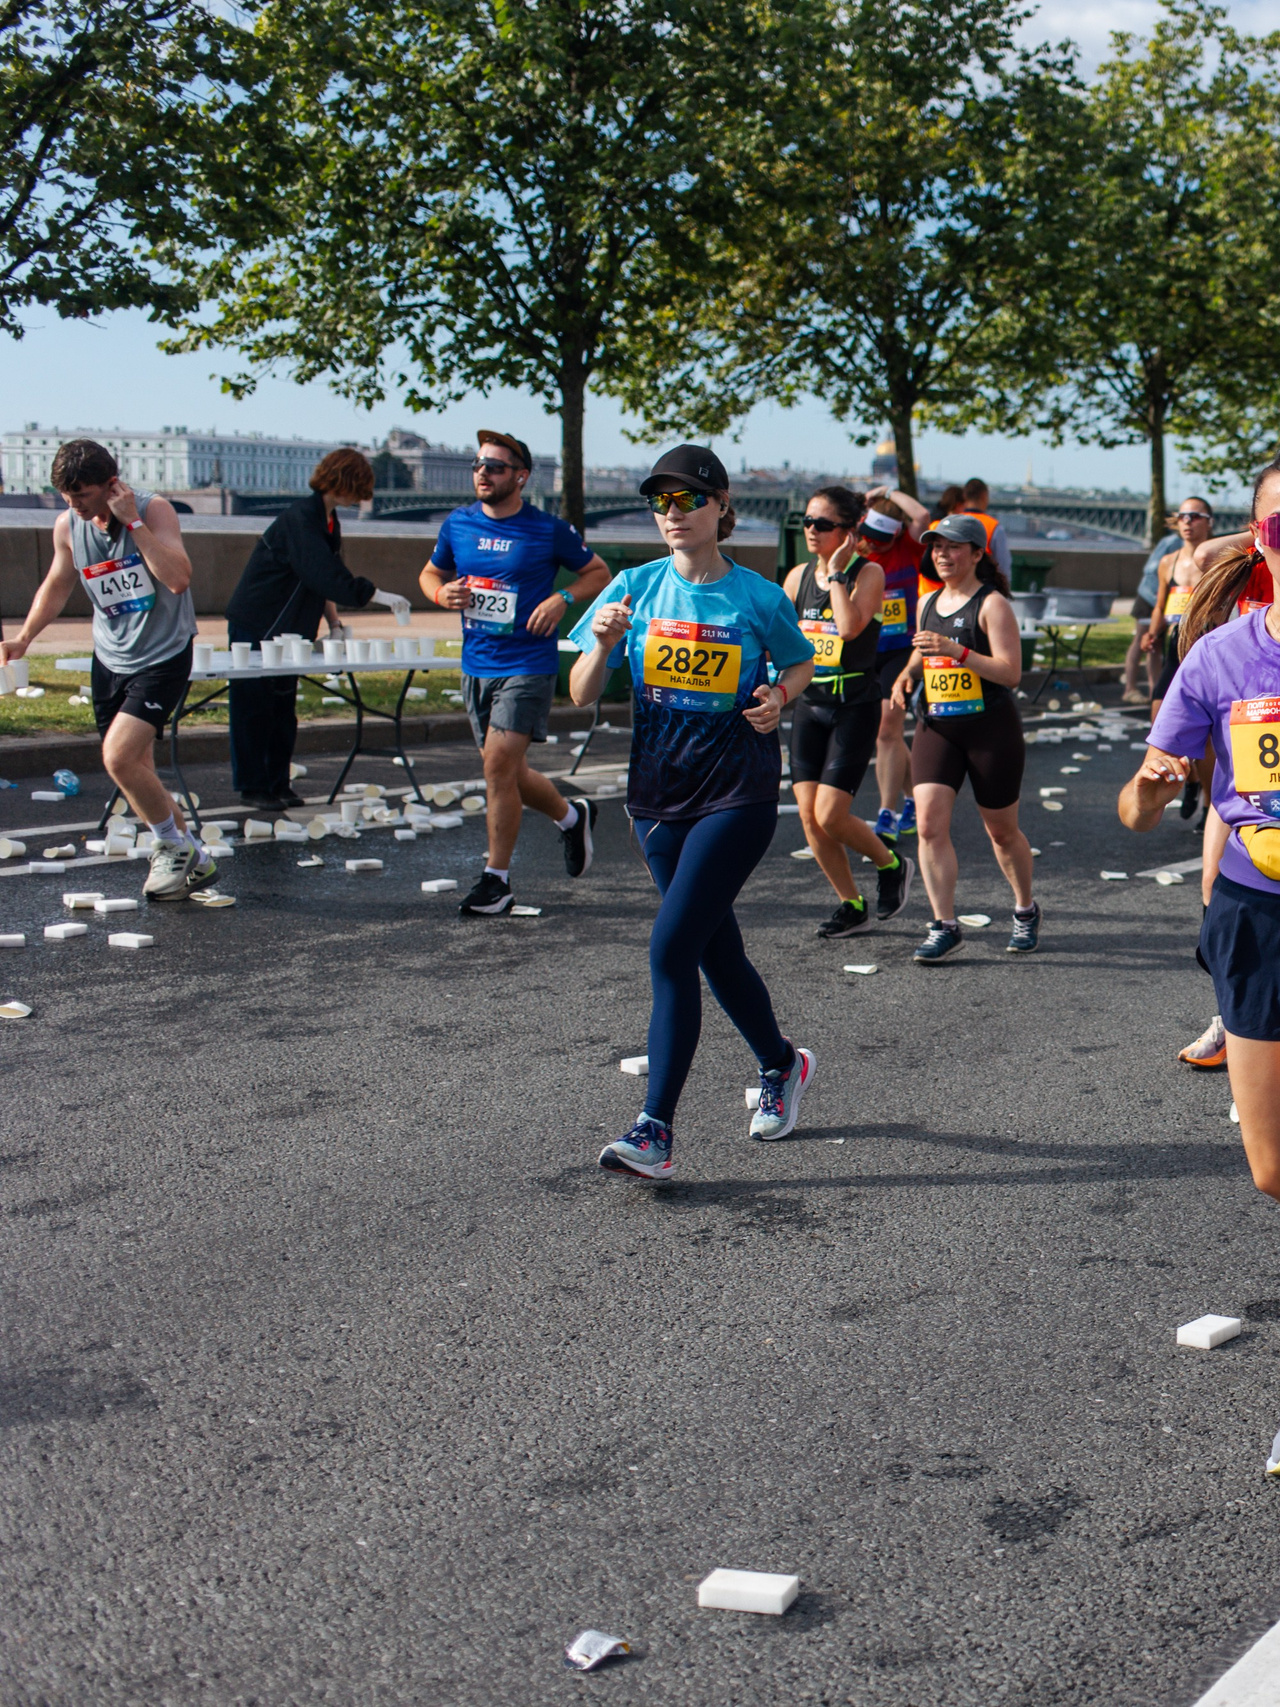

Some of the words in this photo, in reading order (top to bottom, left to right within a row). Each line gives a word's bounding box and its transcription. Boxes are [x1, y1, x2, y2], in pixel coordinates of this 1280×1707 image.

[478, 538, 492, 550] ЗА
[493, 540, 512, 552] БЕГ
[101, 572, 143, 595] 4162
[469, 592, 508, 613] 3923
[884, 602, 901, 617] 68
[660, 626, 690, 634] МАРАФОН
[701, 629, 715, 638] 21,1
[656, 645, 729, 678] 2827
[670, 675, 711, 687] НАТАЛЬЯ
[930, 673, 972, 692] 4878
